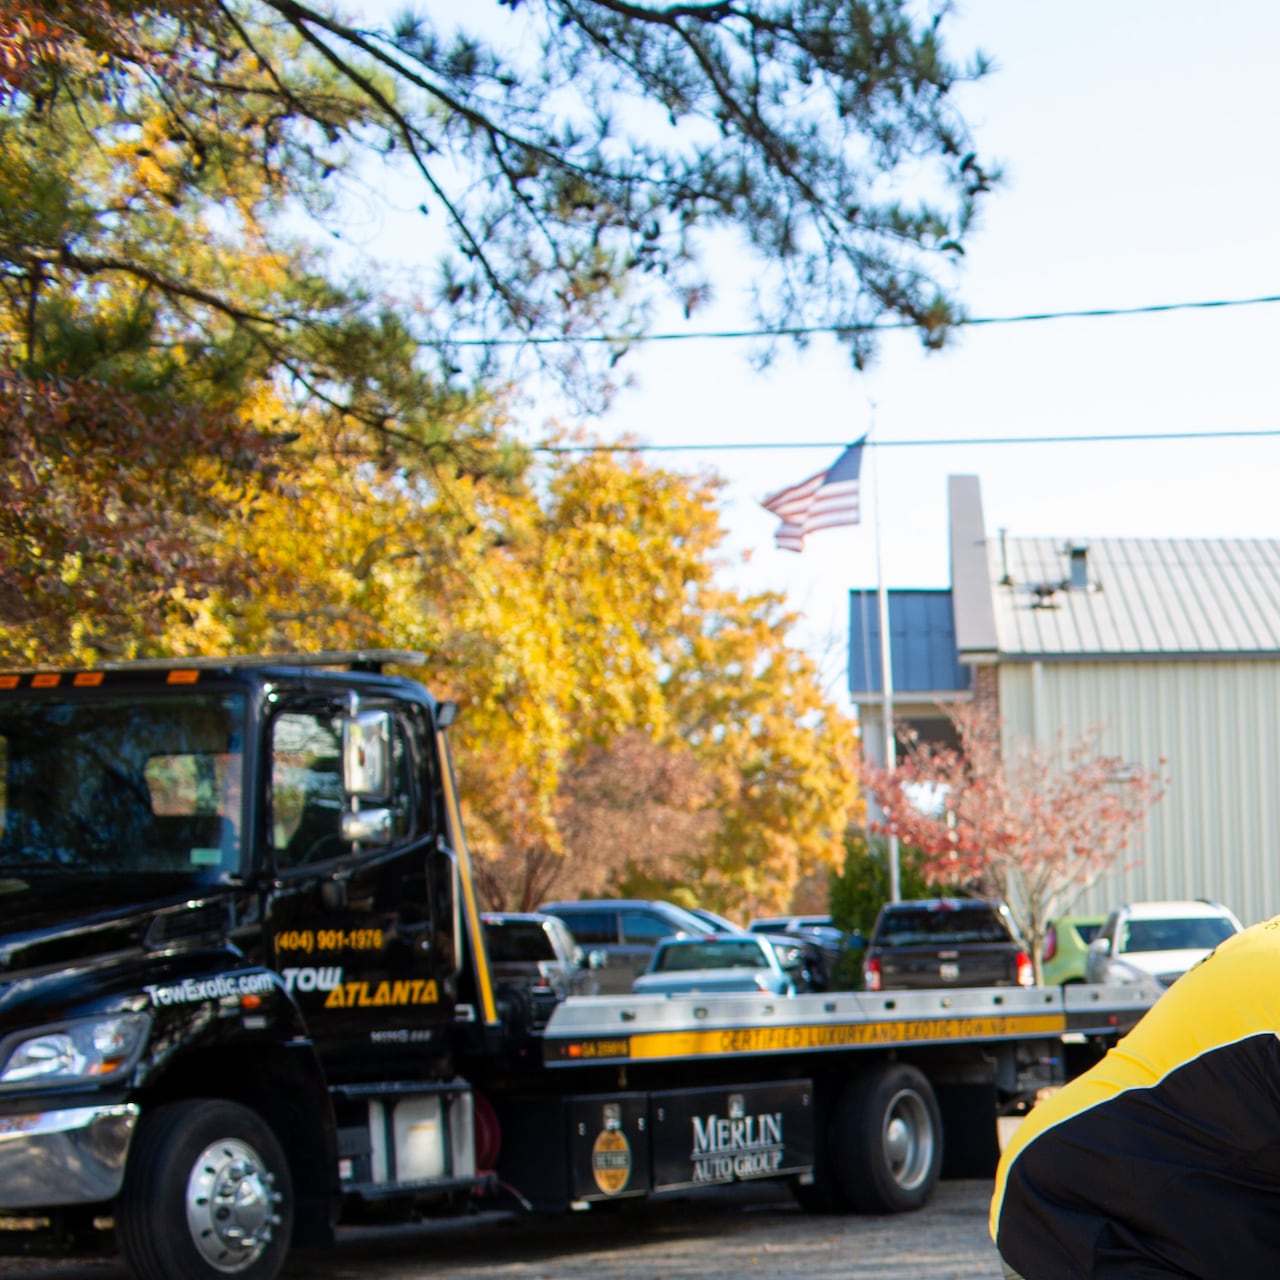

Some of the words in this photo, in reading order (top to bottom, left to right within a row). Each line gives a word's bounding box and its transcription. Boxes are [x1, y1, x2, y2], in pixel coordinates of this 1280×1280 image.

[276, 931, 314, 954] (404)
[317, 929, 382, 950] 901-1976
[147, 973, 275, 1006] TowExotic.com
[283, 967, 343, 992] TOW
[325, 979, 438, 1009] ATLANTA
[720, 1029, 801, 1052] CERTIFIED
[691, 1112, 784, 1154] MERLIN
[692, 1158, 733, 1183] AUTO
